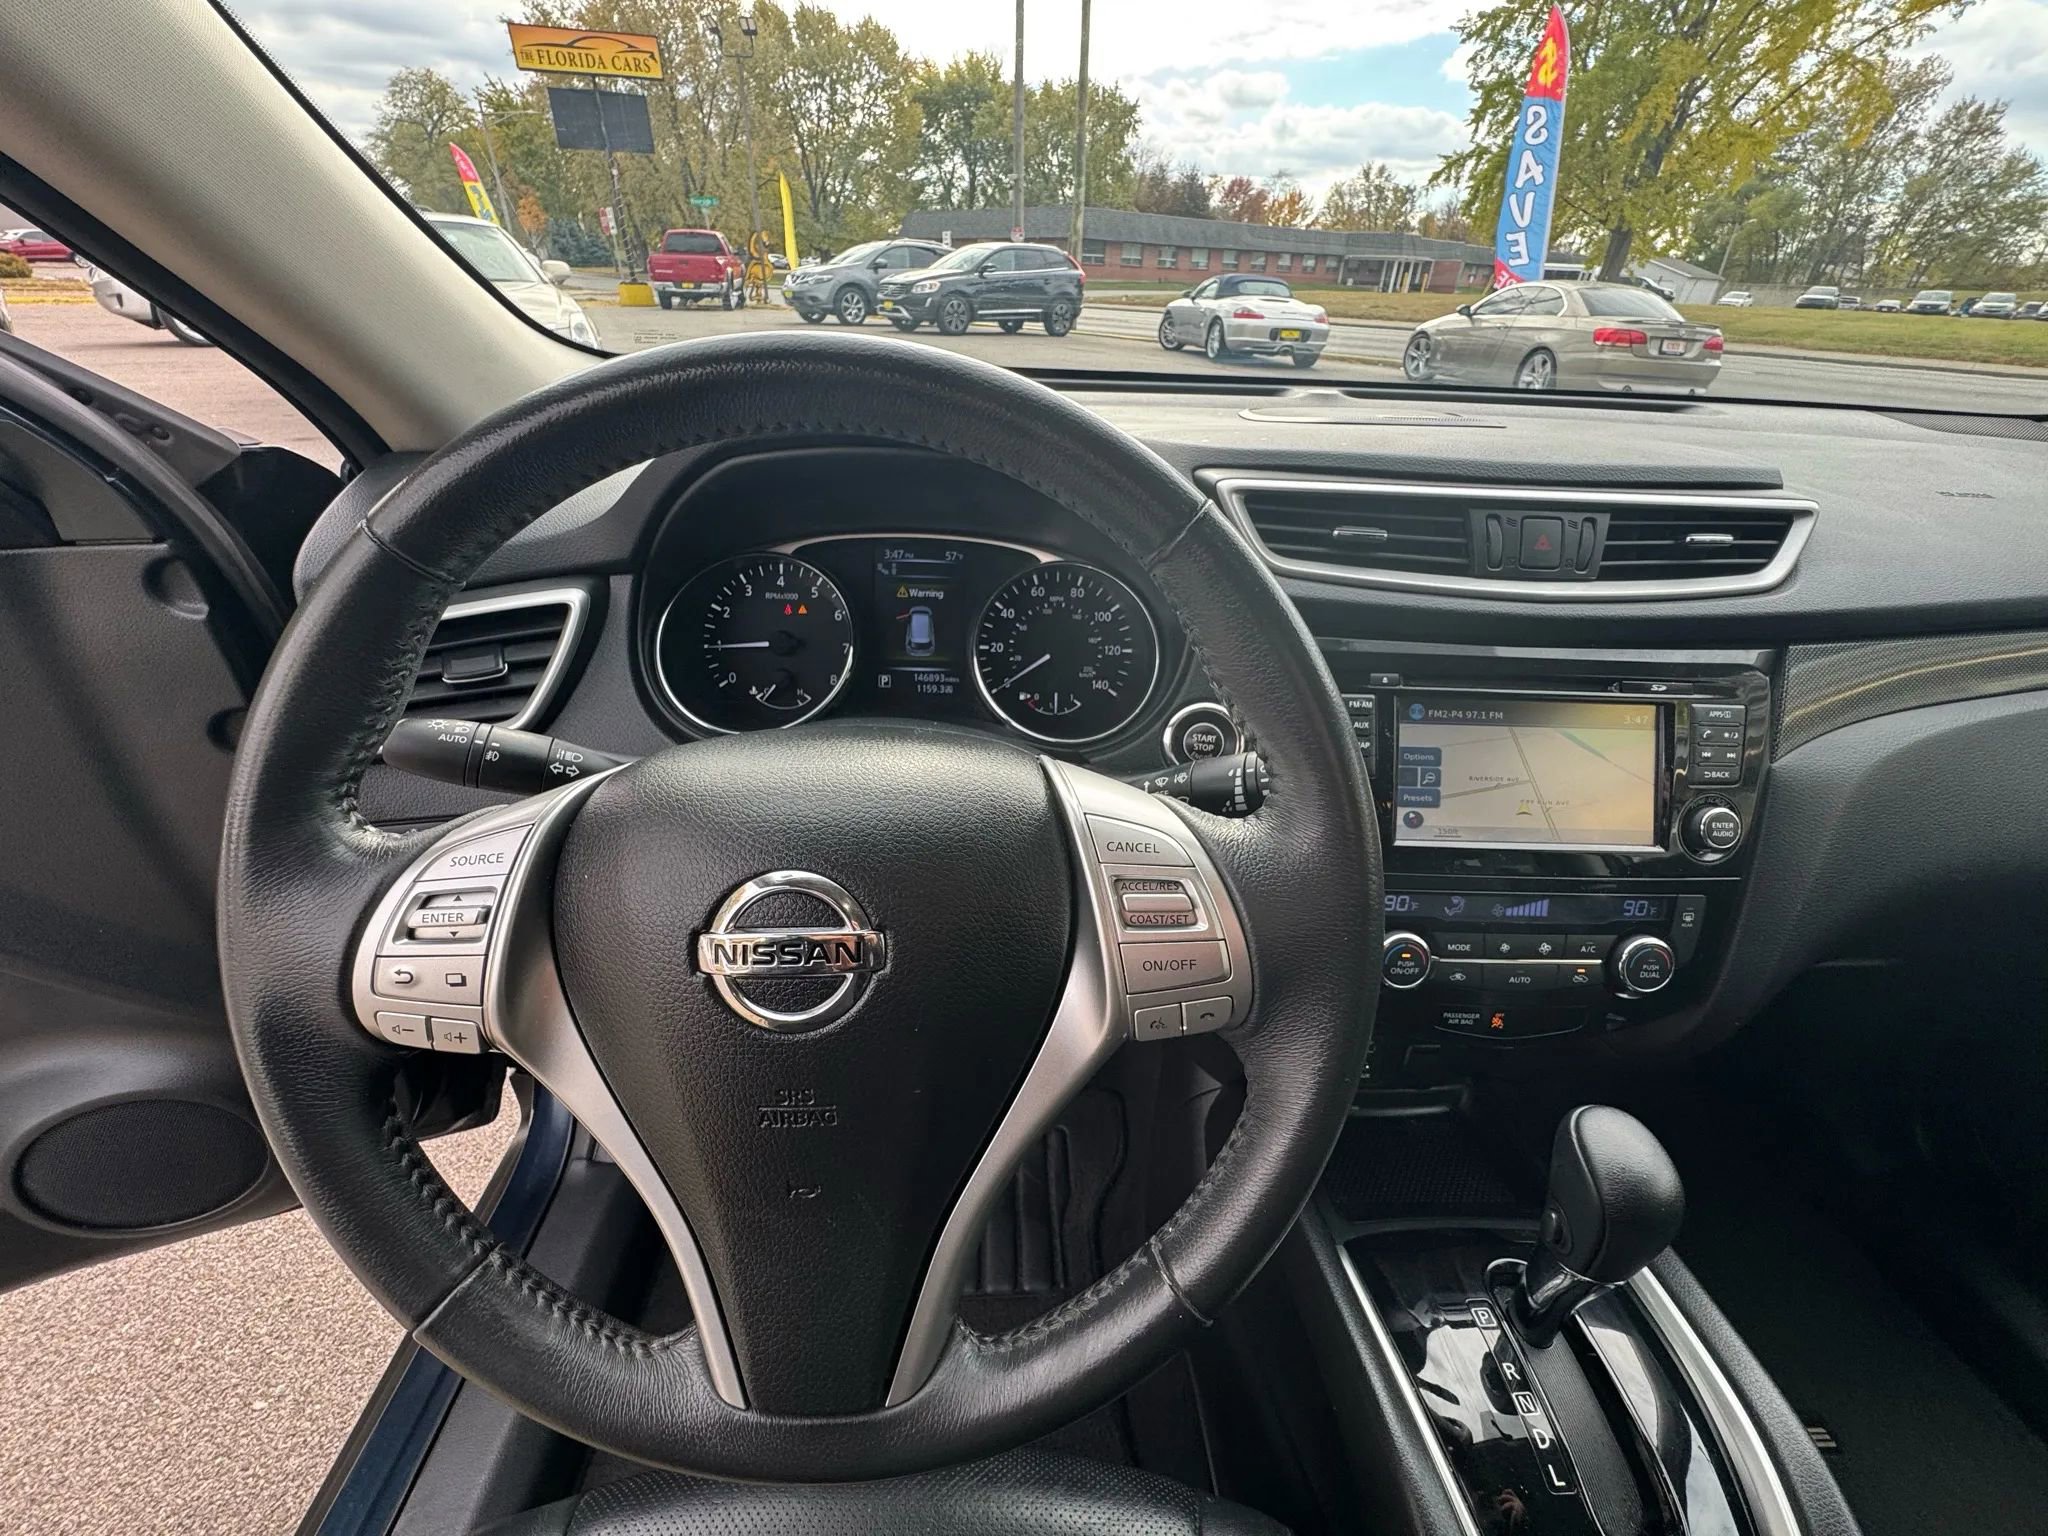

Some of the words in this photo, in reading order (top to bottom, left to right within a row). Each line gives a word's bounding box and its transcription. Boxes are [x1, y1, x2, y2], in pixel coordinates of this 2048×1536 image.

[520, 51, 534, 61] THE
[536, 49, 607, 70] FLORIDA
[611, 55, 651, 73] CARS
[884, 549, 904, 559] 3:47
[777, 576, 785, 587] 4
[745, 585, 752, 596] 3
[811, 587, 819, 598] 5
[909, 588, 944, 600] Warning
[1031, 587, 1045, 597] 60
[1070, 588, 1084, 598] 80
[723, 607, 730, 618] 2
[835, 609, 842, 621] 6
[1001, 609, 1015, 619] 40
[1094, 611, 1112, 622] 100
[842, 643, 850, 654] 7
[990, 643, 1003, 653] 20
[1104, 645, 1121, 656] 120
[729, 672, 736, 683] 0
[830, 675, 837, 686] 8
[914, 673, 945, 682] 146893
[1092, 680, 1109, 690] 140
[1428, 710, 1463, 718] FM2-P4
[1465, 711, 1486, 719] 97.1
[1489, 711, 1503, 720] FM
[1623, 715, 1649, 725] 3:47
[438, 733, 468, 744] AUTO
[1192, 734, 1217, 743] START
[1193, 743, 1214, 752] STOP
[1403, 753, 1434, 762] Options
[1403, 794, 1433, 802] Presets
[1106, 841, 1161, 854] CANCEL
[449, 852, 504, 868] SOURCE
[1120, 881, 1180, 891] ACCEL/RES
[421, 912, 465, 924] ENTER
[1129, 914, 1189, 925] COAST/SET
[713, 941, 863, 968] NISSAN
[1142, 959, 1197, 972] ON/OFF
[1639, 971, 1661, 979] DUAL
[1502, 1363, 1521, 1381] R
[1532, 1428, 1550, 1449] D
[1548, 1464, 1566, 1487] L
